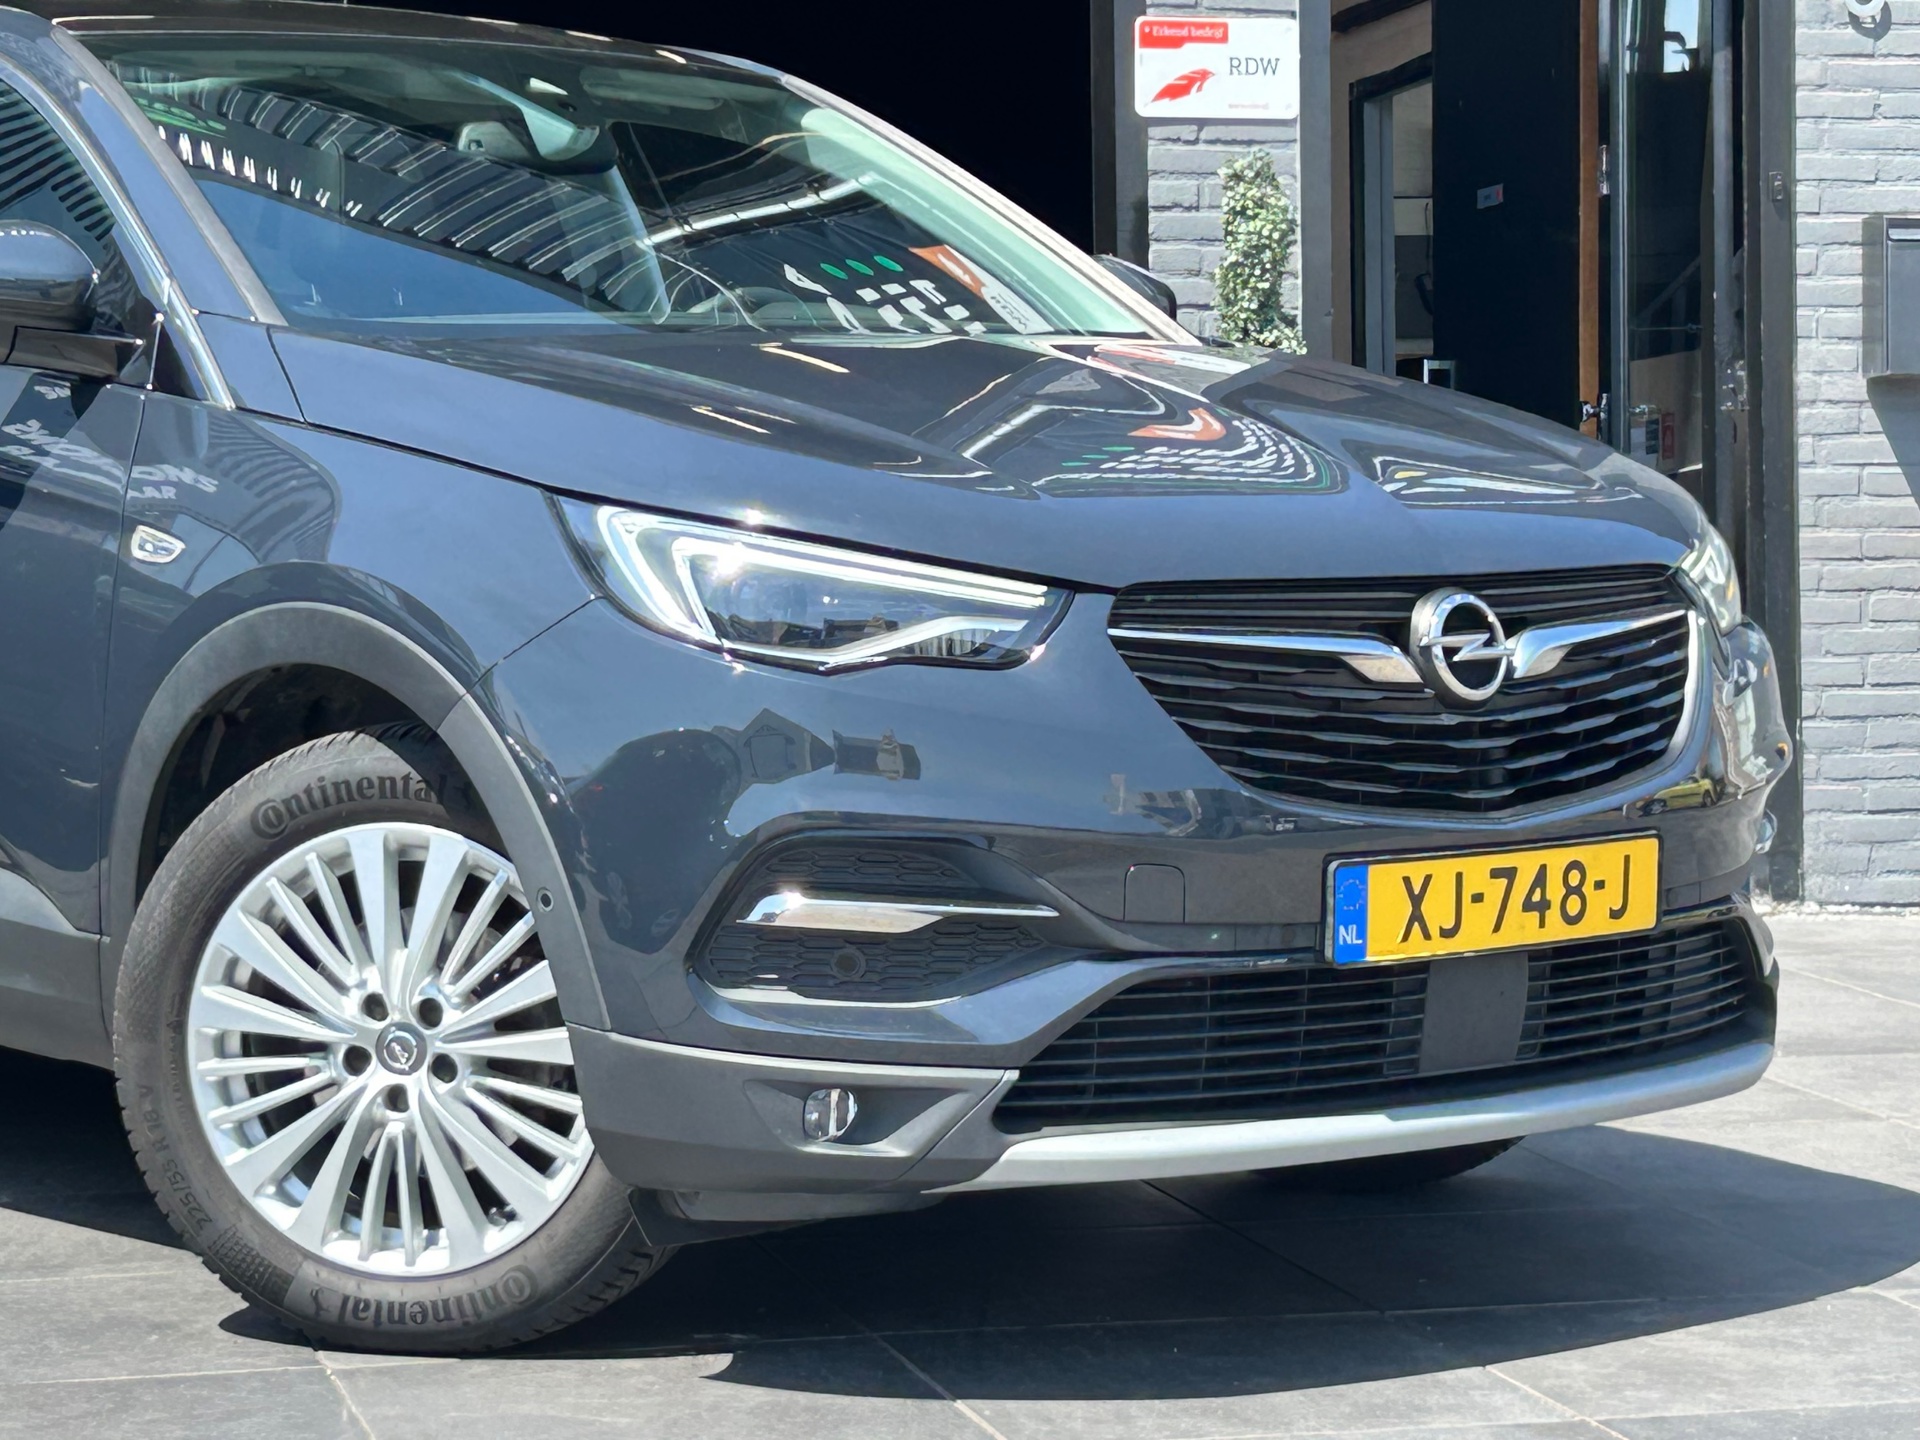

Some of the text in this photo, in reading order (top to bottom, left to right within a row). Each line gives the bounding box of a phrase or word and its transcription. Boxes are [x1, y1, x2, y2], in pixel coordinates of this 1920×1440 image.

[1229, 57, 1280, 76] RDW
[250, 771, 448, 840] Continental
[1399, 854, 1631, 943] XJ-748-J
[1338, 924, 1363, 945] NL
[337, 1264, 539, 1327] Continental
